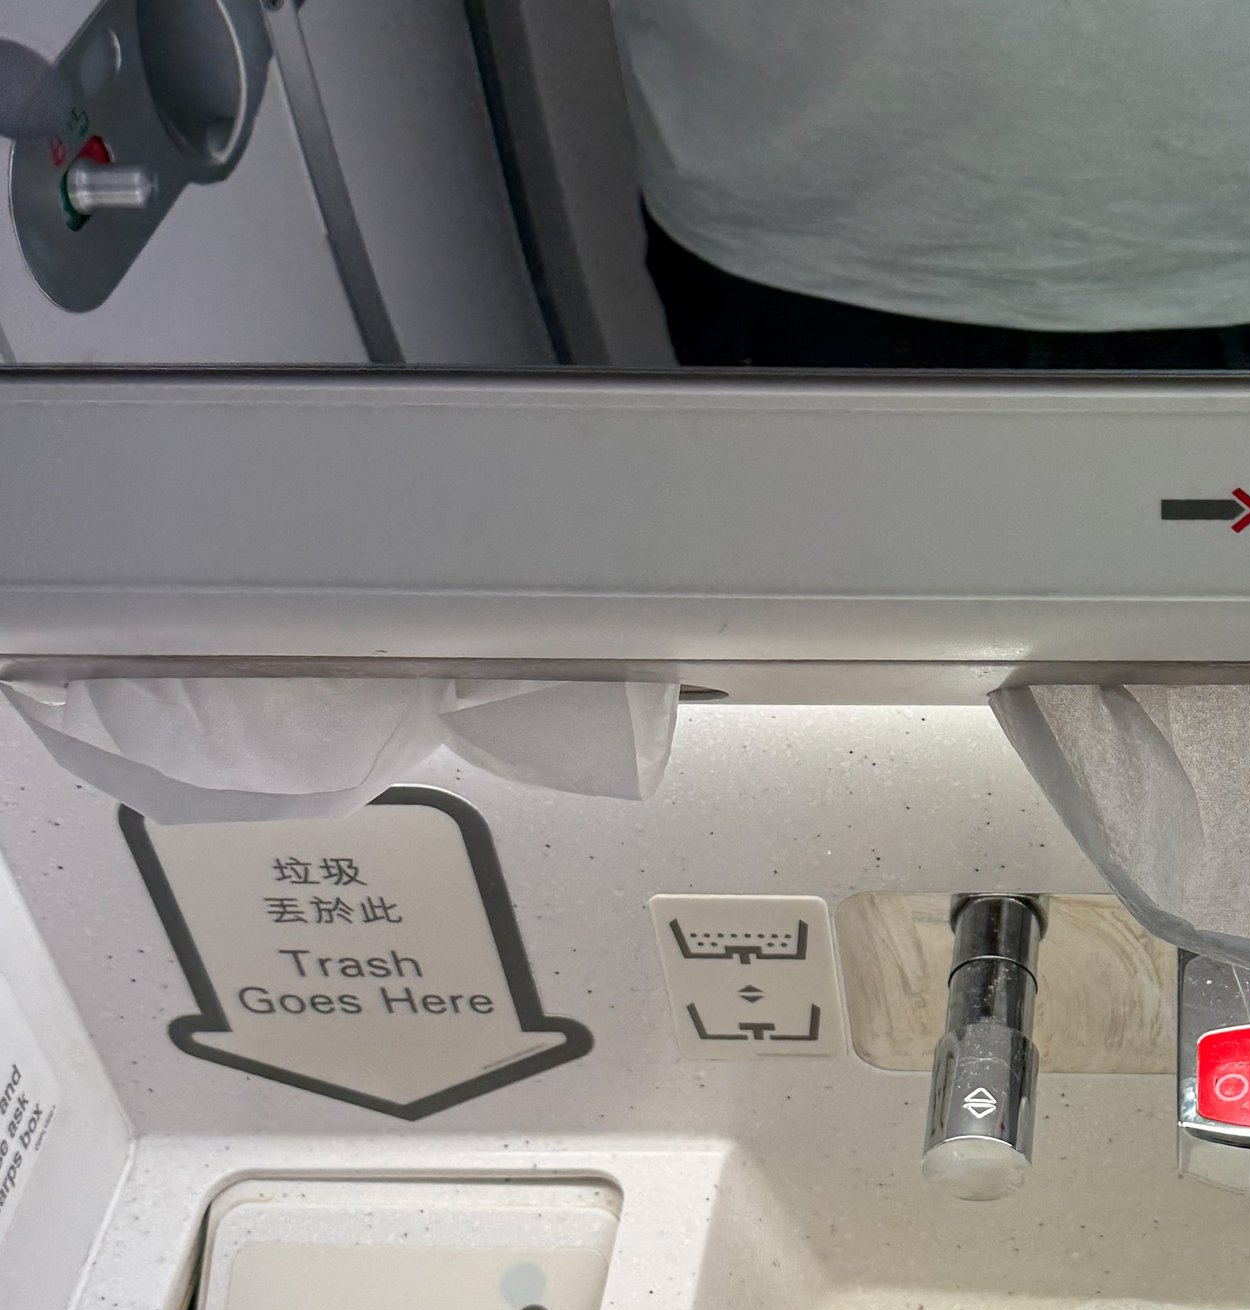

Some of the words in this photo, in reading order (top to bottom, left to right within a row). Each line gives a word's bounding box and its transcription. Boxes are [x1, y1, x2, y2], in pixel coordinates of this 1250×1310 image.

[273, 857, 368, 886] 垃圾
[264, 896, 403, 924] 丟於此
[278, 950, 423, 978] Trash
[238, 986, 364, 1015] Goes
[379, 986, 495, 1015] Here
[0, 1064, 22, 1116] and
[7, 1092, 30, 1139] ask
[0, 1151, 23, 1213] arps
[19, 1102, 44, 1150] box
